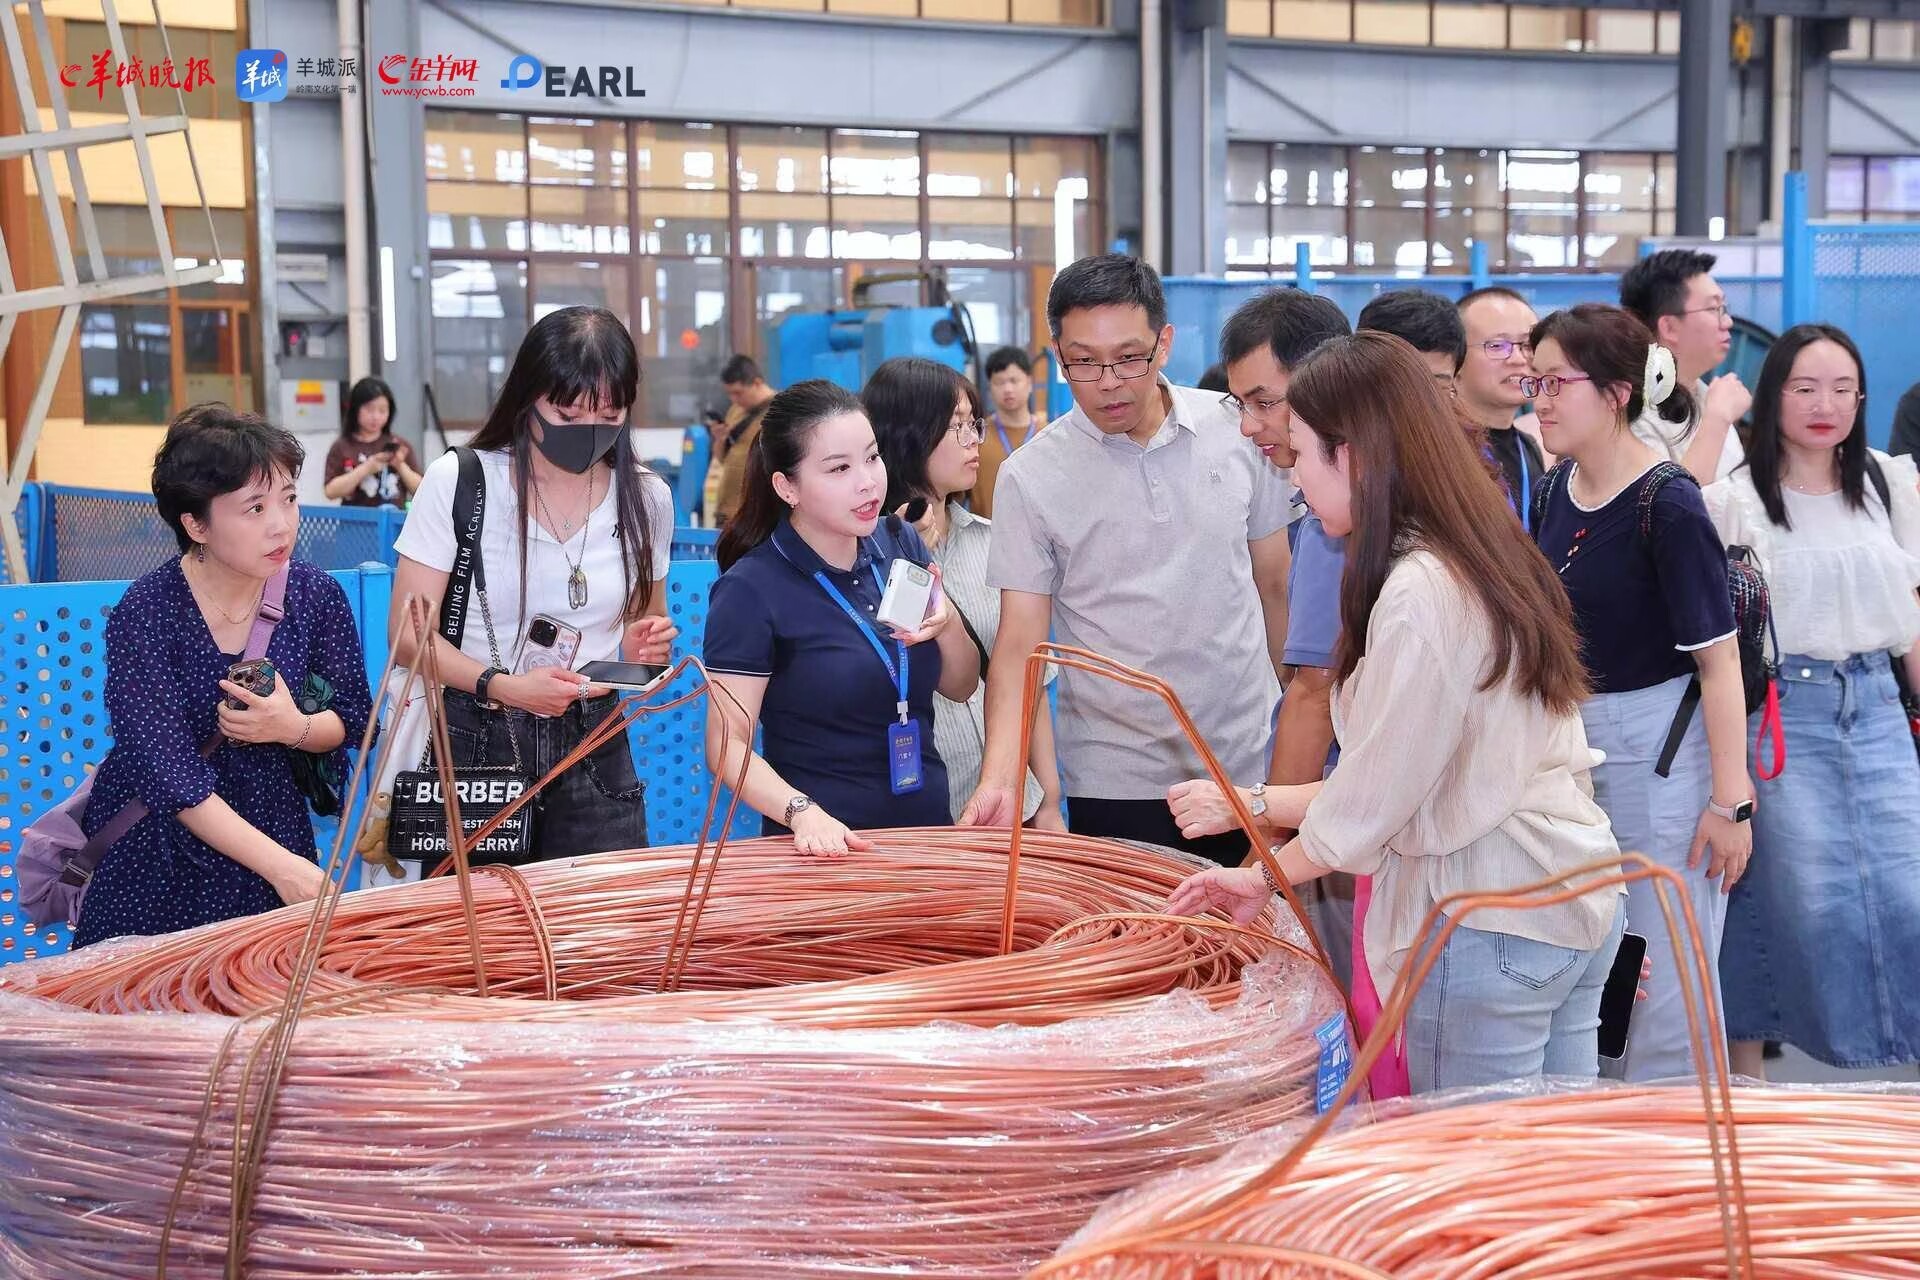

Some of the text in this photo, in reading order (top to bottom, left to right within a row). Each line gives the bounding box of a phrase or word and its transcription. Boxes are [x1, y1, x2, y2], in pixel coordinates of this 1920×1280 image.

[447, 584, 465, 636] BEIJING
[457, 547, 472, 578] FILM
[463, 819, 522, 829] ESTLISH
[411, 837, 520, 851] HORERRY
